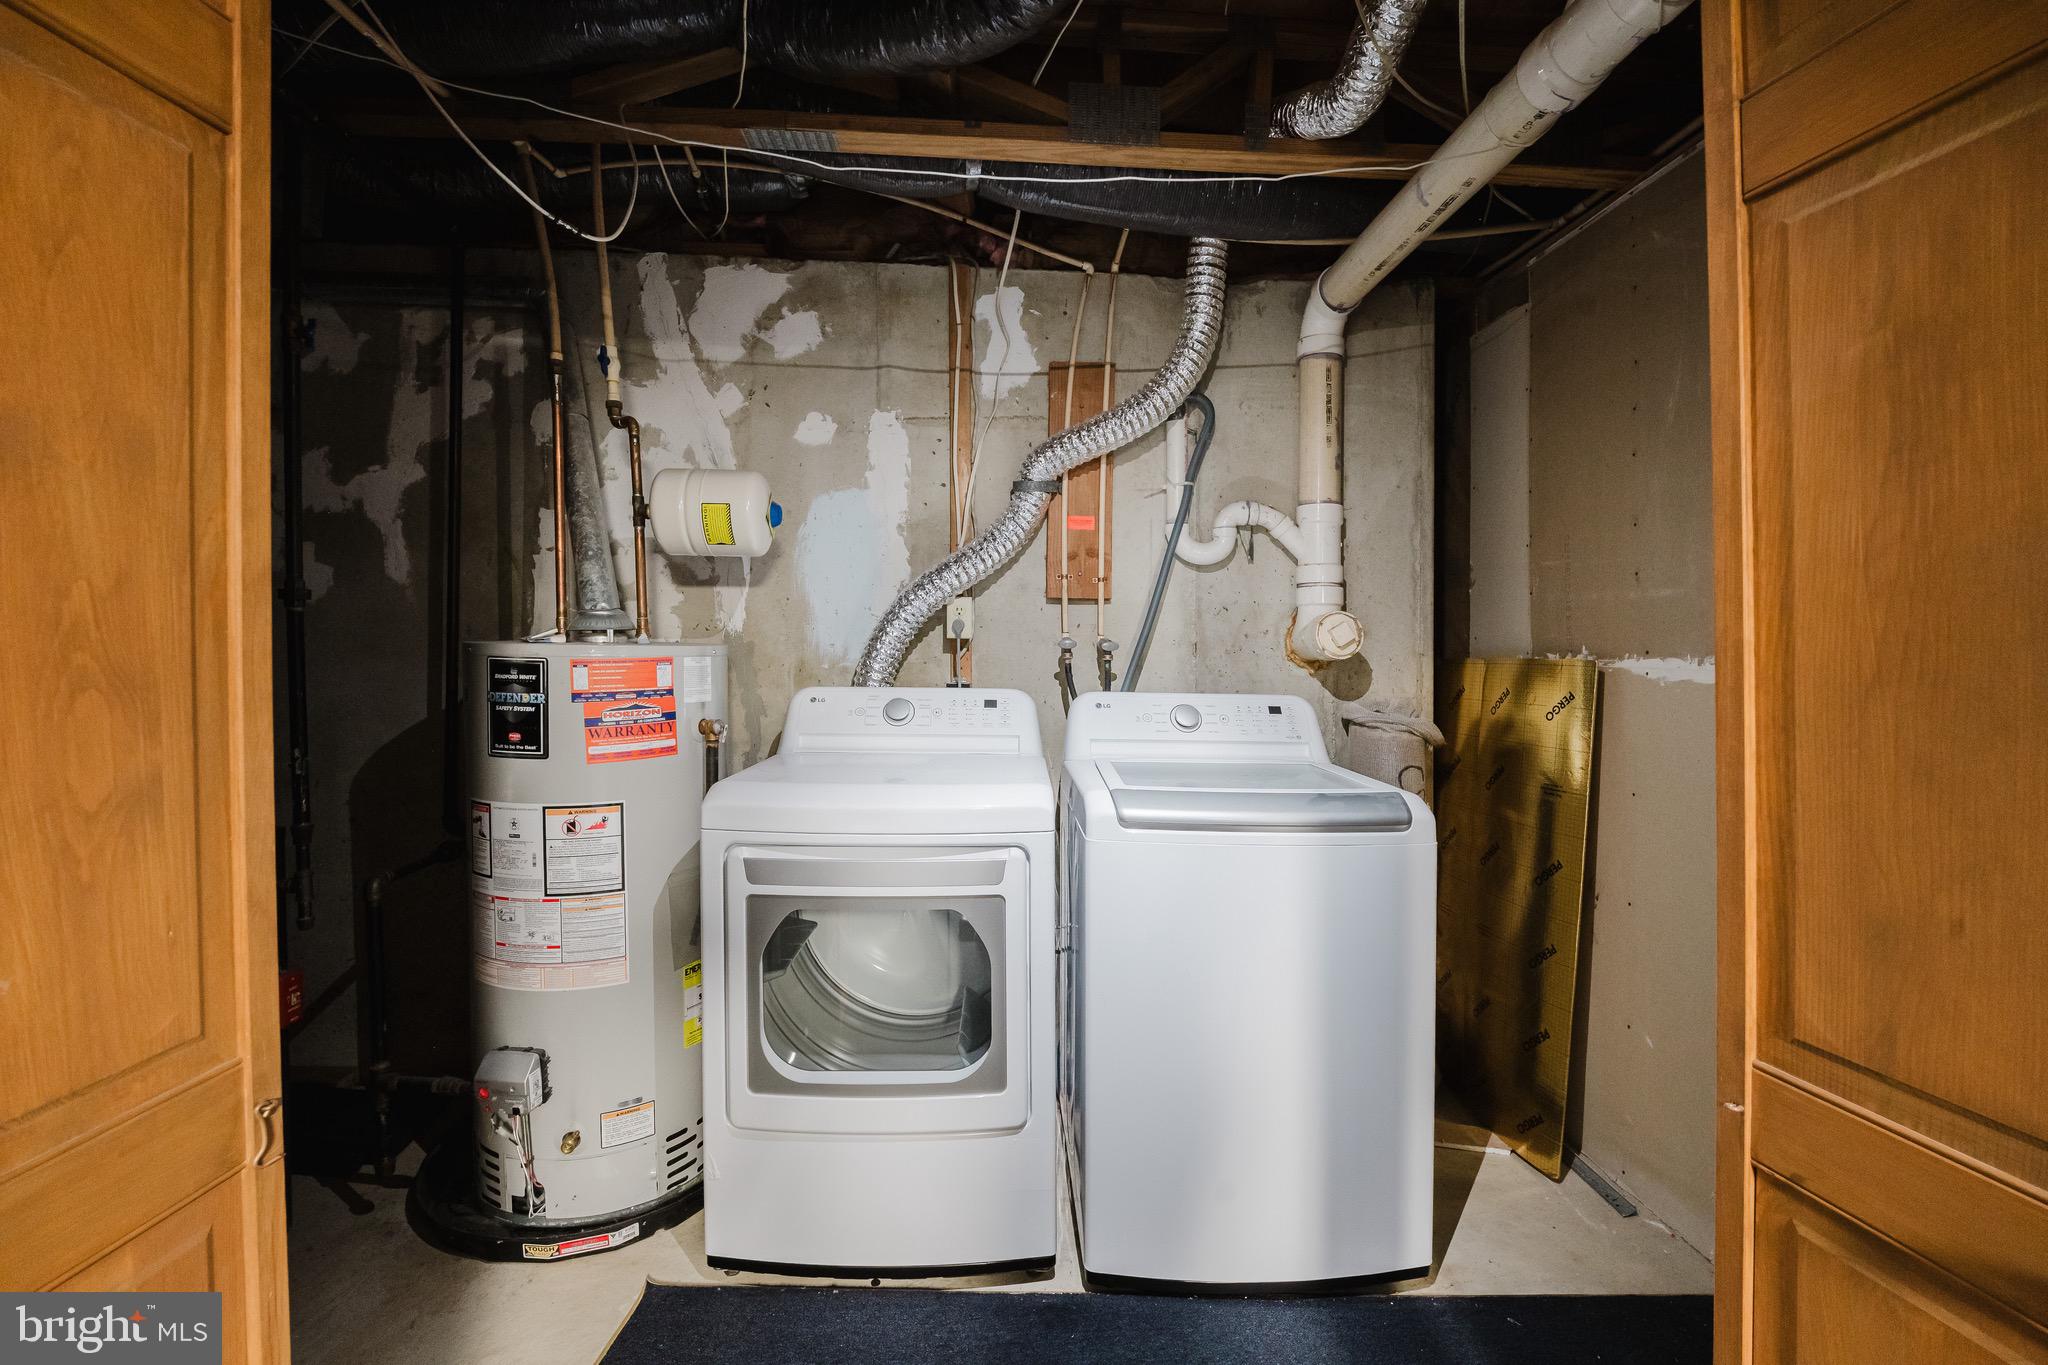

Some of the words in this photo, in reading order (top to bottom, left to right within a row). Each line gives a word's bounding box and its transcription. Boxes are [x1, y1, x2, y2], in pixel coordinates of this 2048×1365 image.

[489, 692, 546, 704] DEFENDER
[1490, 687, 1511, 716] PERGO
[1545, 691, 1577, 722] PERGO
[603, 708, 661, 719] HORIZON
[588, 721, 674, 739] WARRANTY
[1534, 860, 1564, 888] PERGO
[1530, 944, 1557, 969] PERGO
